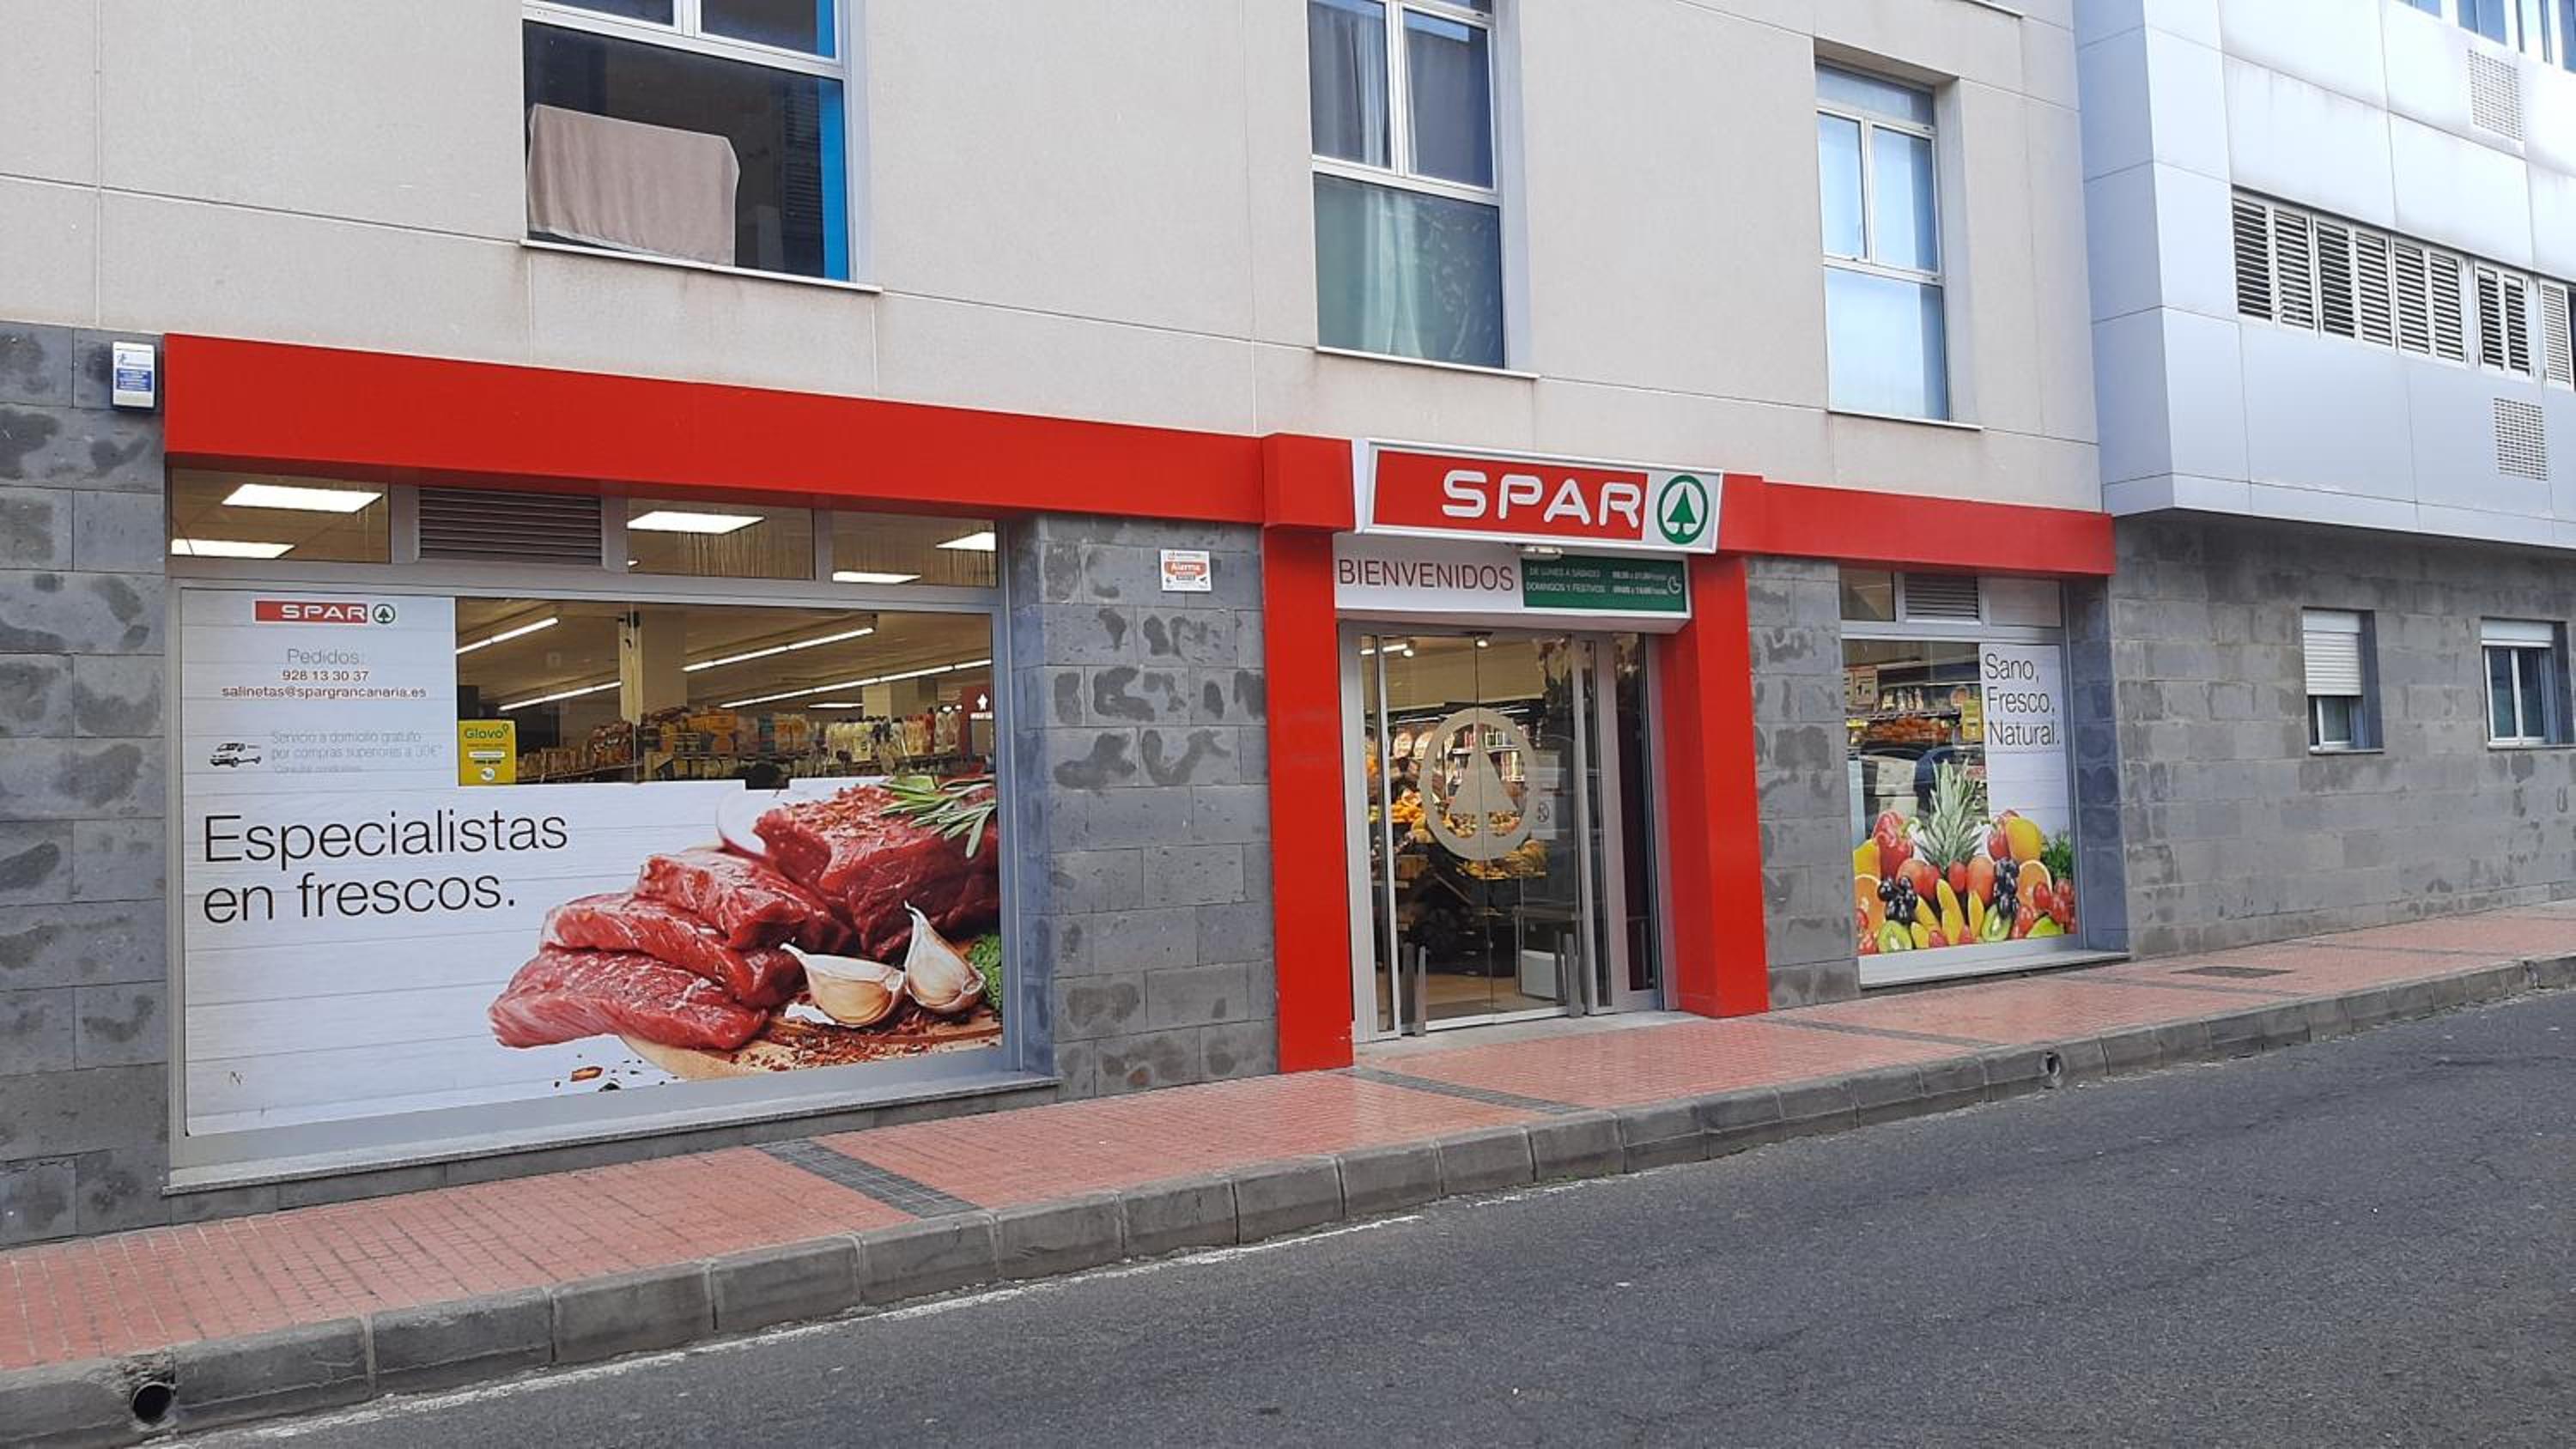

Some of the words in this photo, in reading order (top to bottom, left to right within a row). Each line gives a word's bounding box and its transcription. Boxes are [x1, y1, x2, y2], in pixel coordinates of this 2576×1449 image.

[1442, 469, 1641, 528] SPAR
[1339, 559, 1515, 591] BIENVENIDOS
[282, 603, 367, 621] SPAR
[283, 670, 308, 681] 928
[313, 670, 329, 681] 13
[333, 670, 349, 681] 30
[353, 670, 369, 681] 37
[1985, 653, 2039, 684] Sano,
[465, 727, 504, 739] Glovo
[1989, 720, 2060, 745] Natural.
[204, 809, 568, 871] Especialistas
[204, 884, 274, 924] en
[296, 872, 516, 919] frescos.
